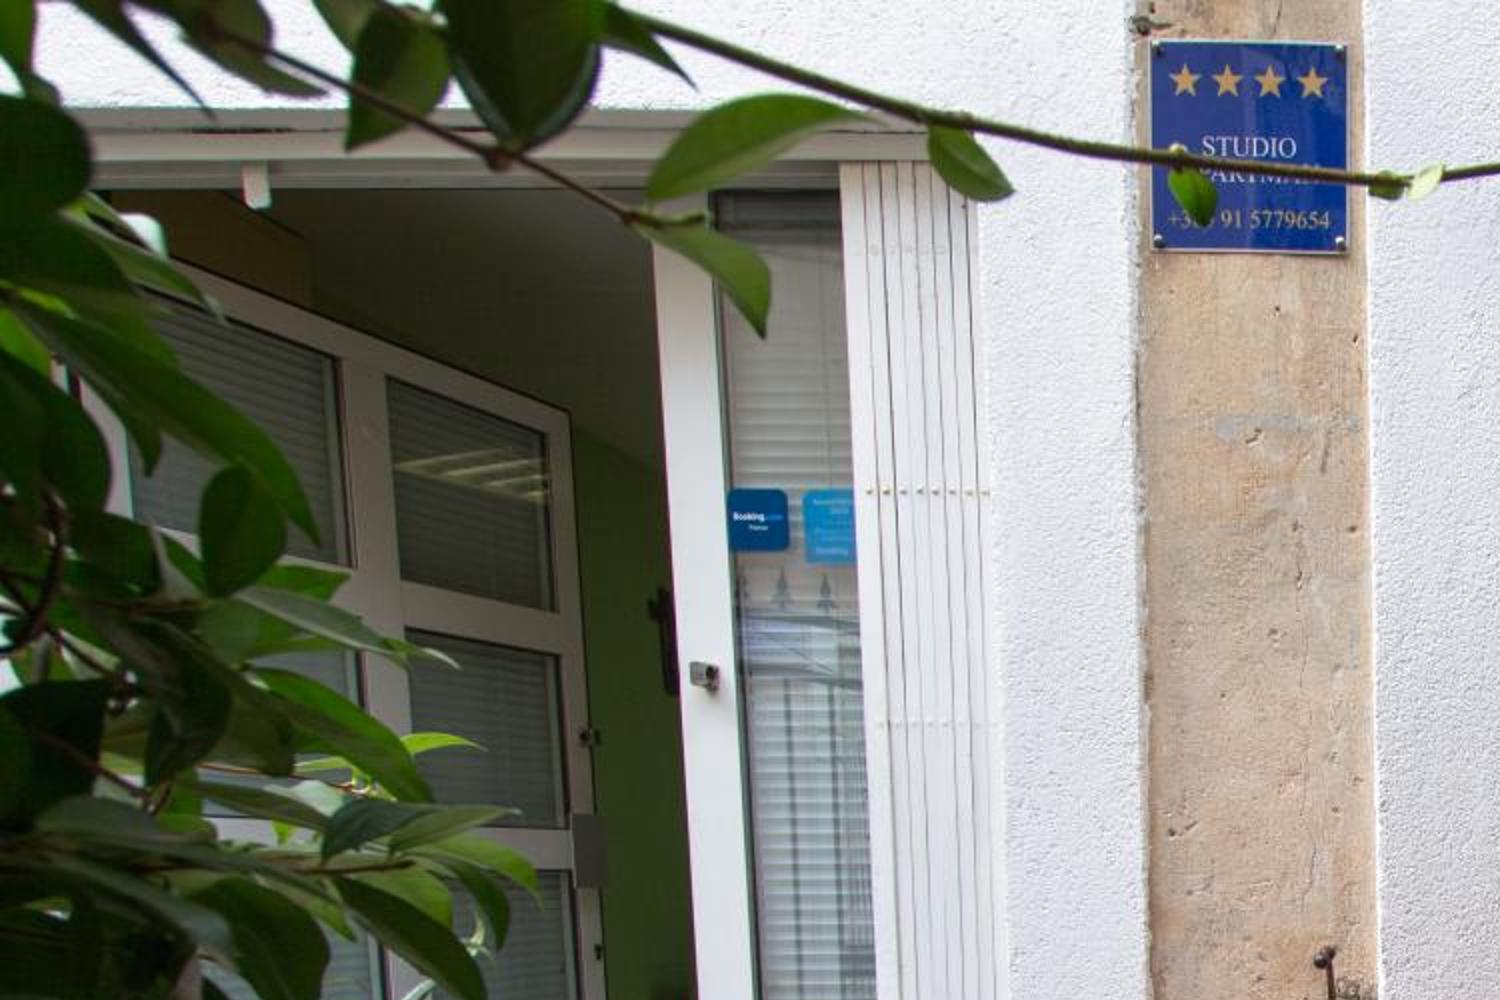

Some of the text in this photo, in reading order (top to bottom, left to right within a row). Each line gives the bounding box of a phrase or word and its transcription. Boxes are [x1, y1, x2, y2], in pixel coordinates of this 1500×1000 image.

[1202, 136, 1297, 158] STUDIO
[1220, 208, 1242, 230] 91
[1249, 208, 1330, 231] 5779654
